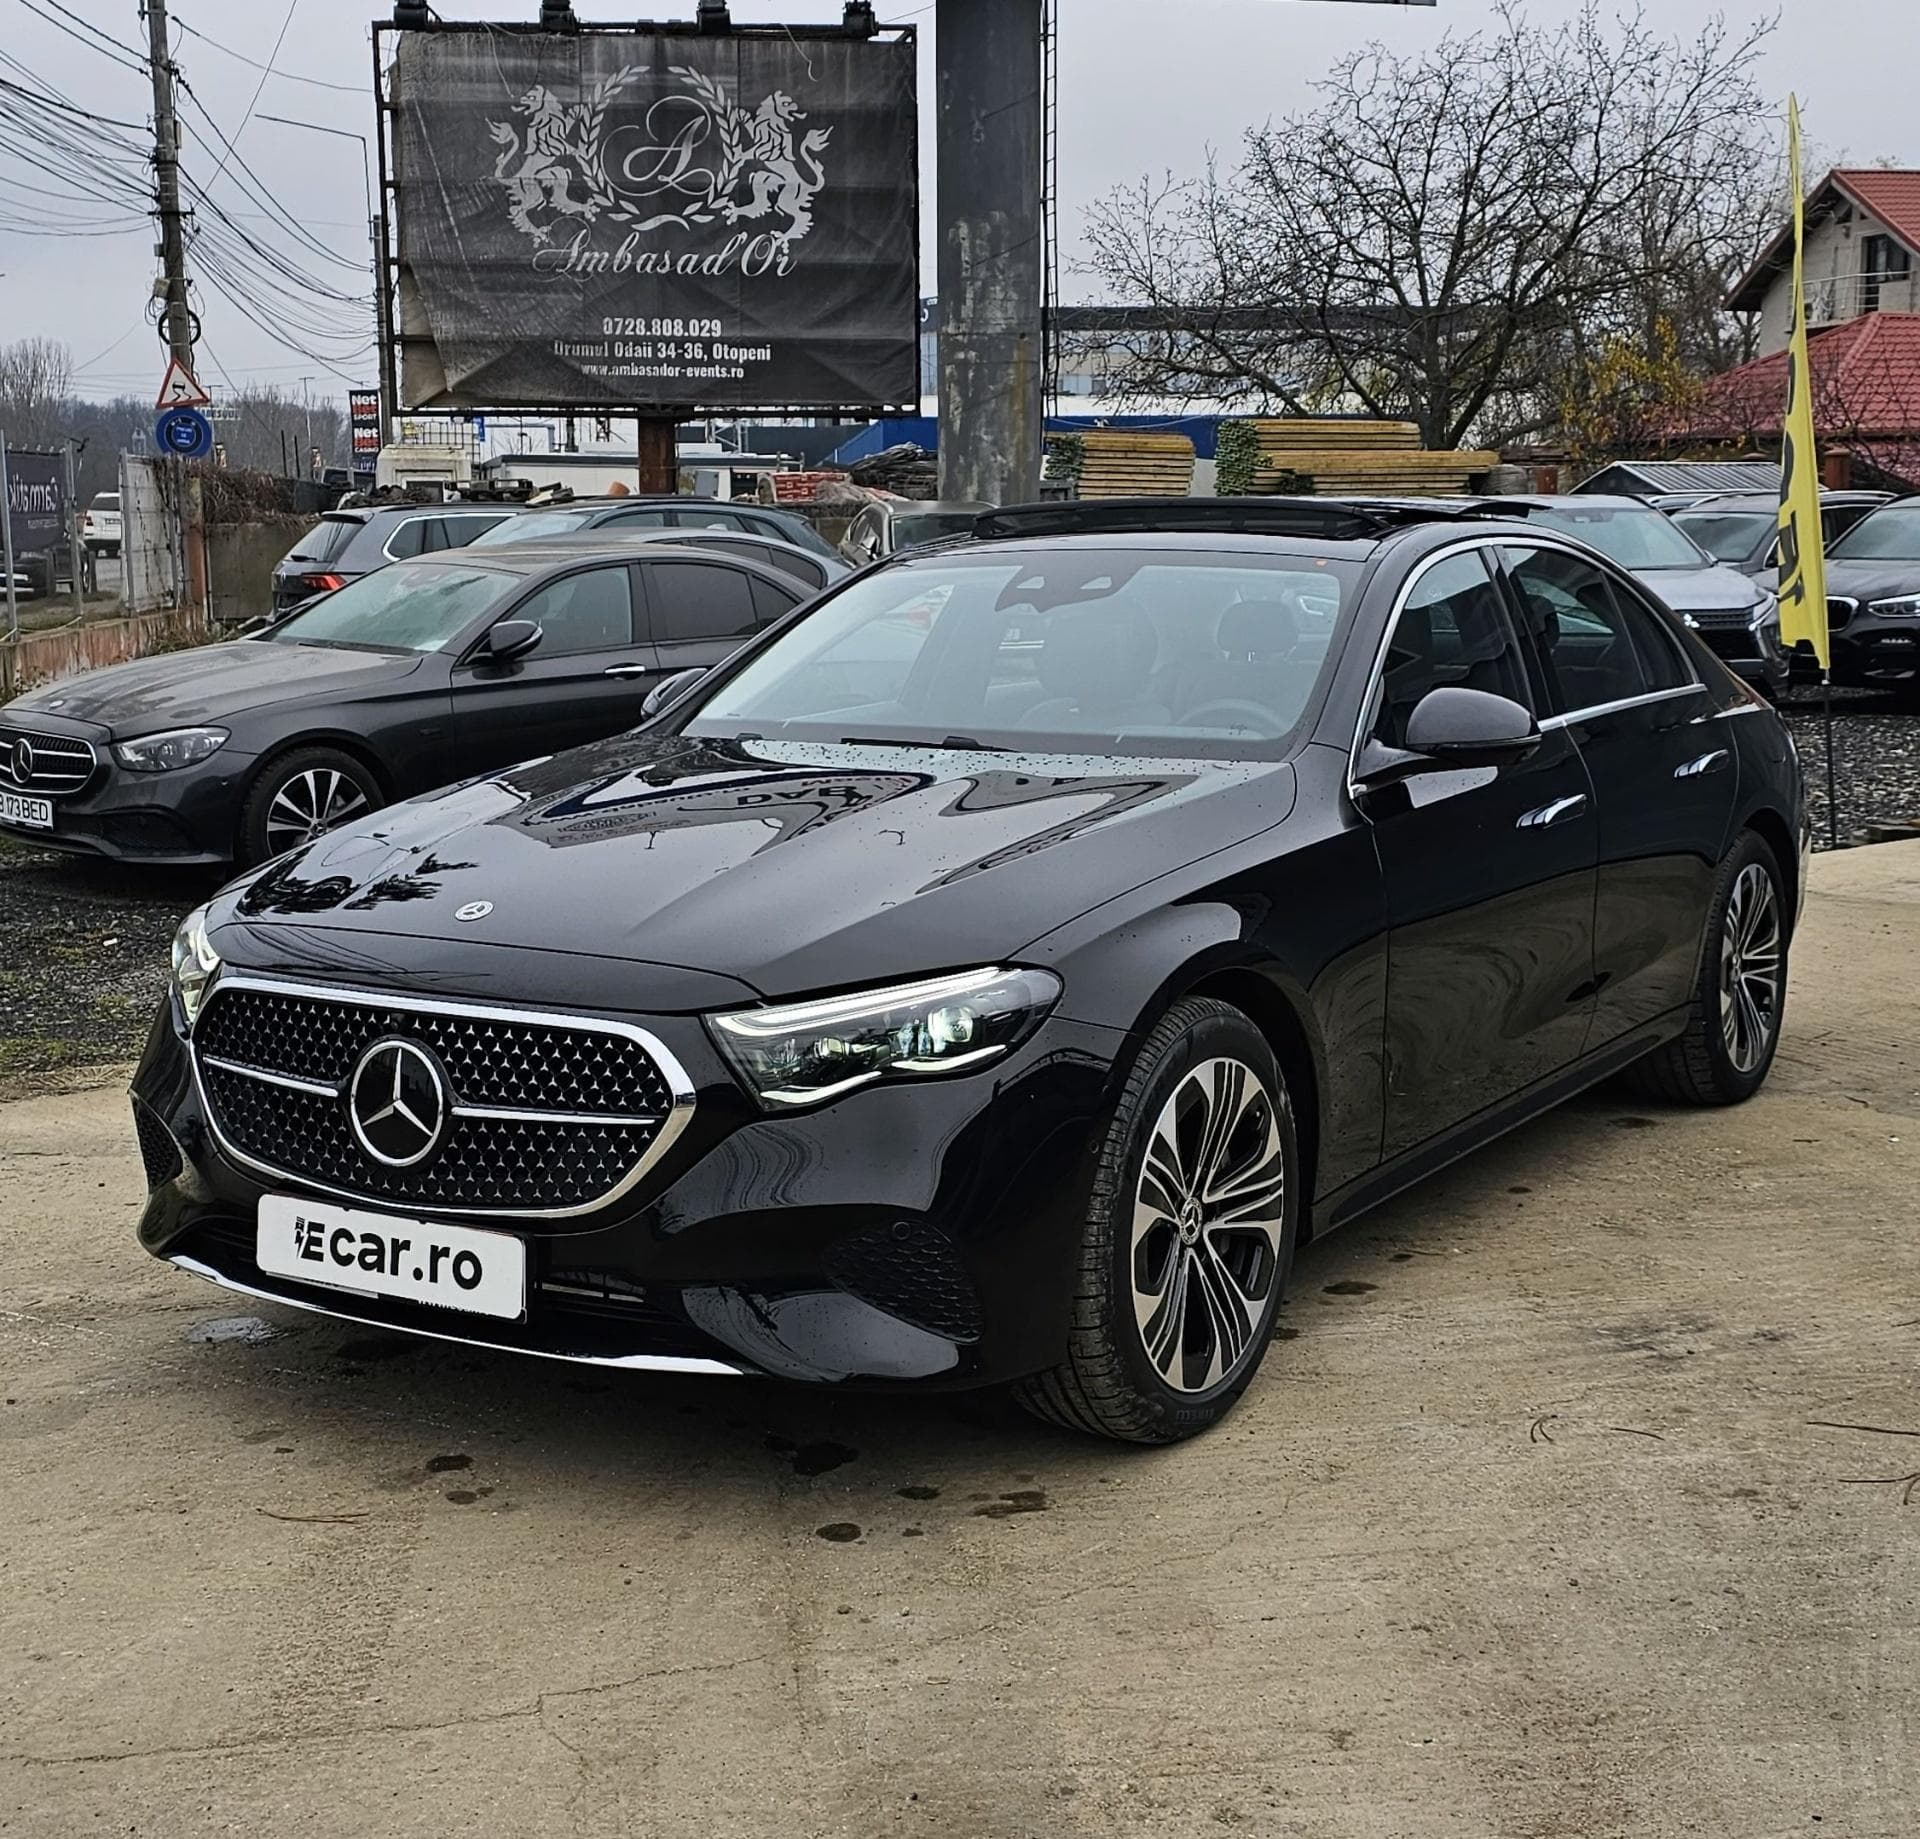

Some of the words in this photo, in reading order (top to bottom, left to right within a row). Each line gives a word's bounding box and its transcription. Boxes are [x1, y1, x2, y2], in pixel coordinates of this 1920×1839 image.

[603, 317, 722, 337] 0728.808.029
[554, 340, 609, 357] Drumul
[614, 342, 652, 358] Odaii
[657, 342, 708, 361] 34-36,
[713, 343, 772, 364] Otopeni
[581, 363, 744, 378] www.ambasador-events.ro
